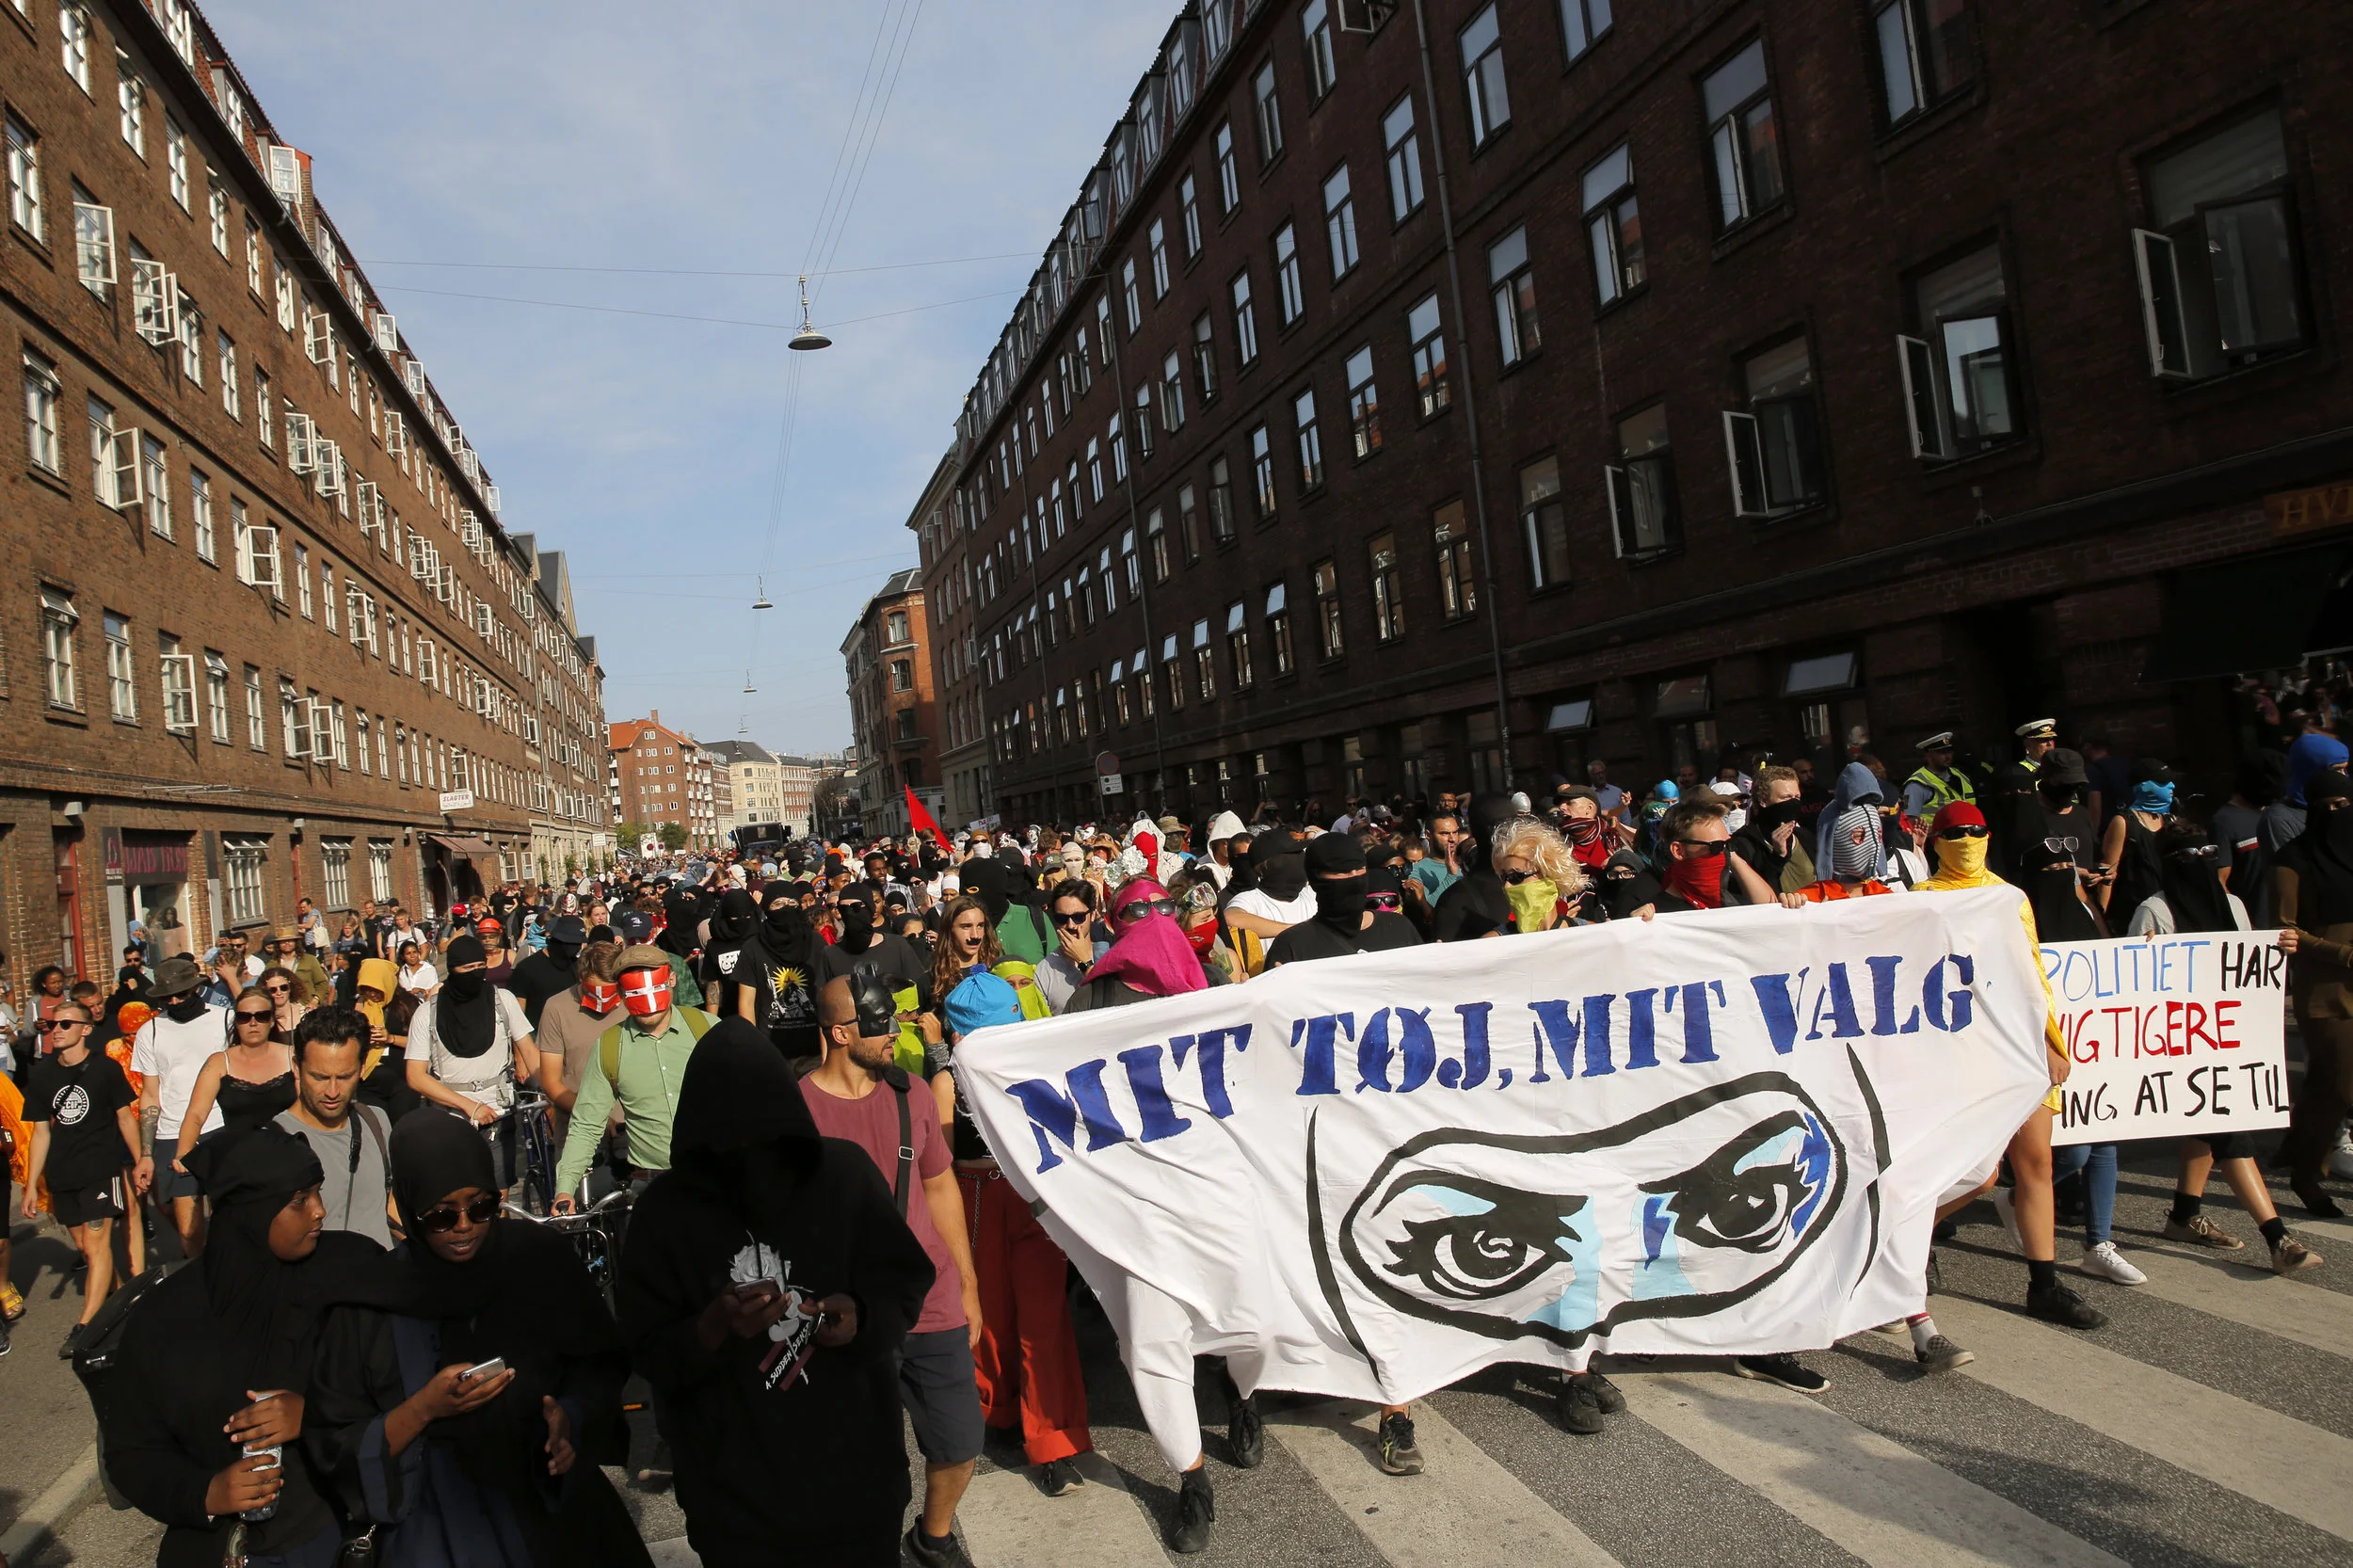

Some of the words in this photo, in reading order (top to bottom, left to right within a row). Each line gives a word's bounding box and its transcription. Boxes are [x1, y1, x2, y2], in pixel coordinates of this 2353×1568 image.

[2040, 941, 2211, 1001] POLITIET
[2221, 941, 2285, 992] HAR
[1005, 1023, 1253, 1175] MIT
[1528, 980, 1726, 1084] MIT
[1751, 952, 1975, 1055] VALG
[2061, 1082, 2119, 1128] ING
[2134, 1071, 2173, 1116] AT
[2184, 1066, 2232, 1117] SE
[2239, 1062, 2290, 1112] TIL
[765, 1380, 772, 1390] A
[770, 1350, 793, 1384] SUDDEN
